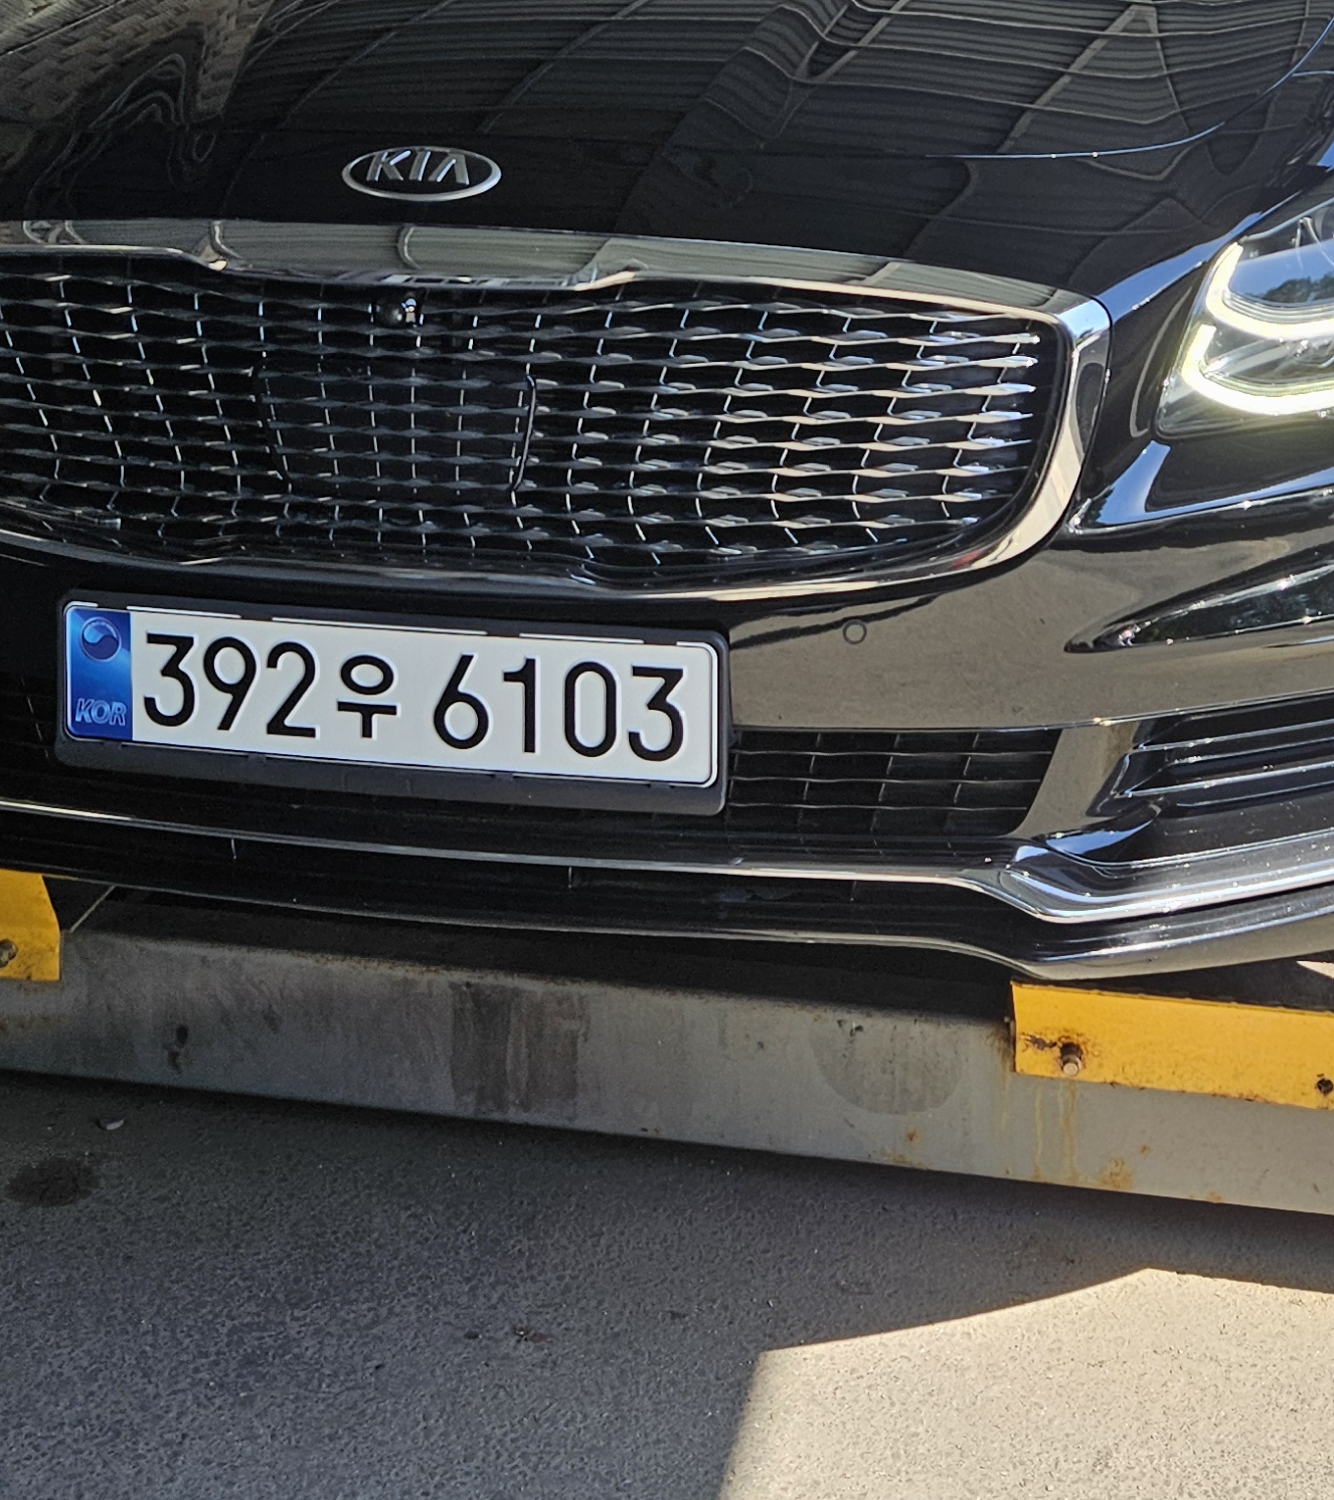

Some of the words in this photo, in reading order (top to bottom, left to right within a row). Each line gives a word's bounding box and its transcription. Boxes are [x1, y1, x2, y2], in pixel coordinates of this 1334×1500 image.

[366, 150, 470, 185] KIA
[75, 697, 127, 726] KOR
[142, 632, 399, 740] 392우
[433, 653, 686, 762] 6103
